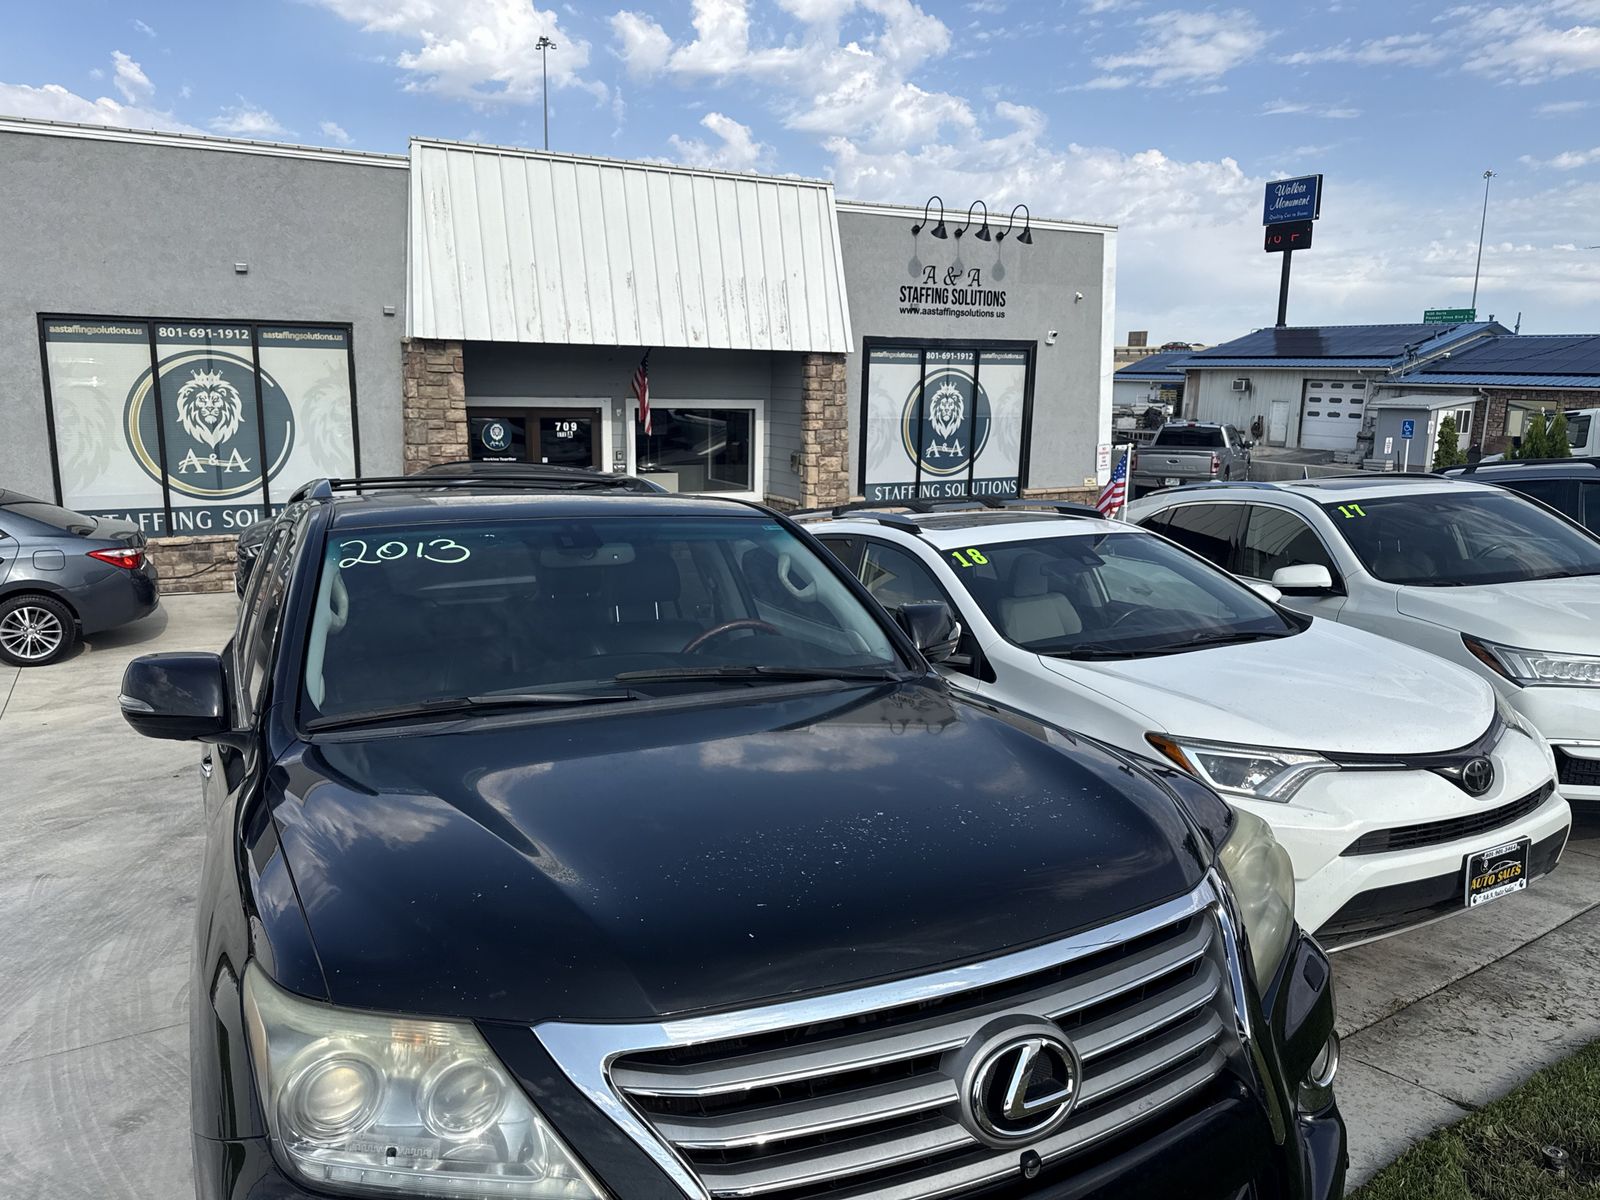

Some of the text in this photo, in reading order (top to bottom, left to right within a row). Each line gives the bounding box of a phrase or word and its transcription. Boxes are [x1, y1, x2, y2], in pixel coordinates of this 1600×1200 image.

[1274, 182, 1306, 196] Walker
[1270, 195, 1310, 210] Monument
[922, 265, 982, 287] A & A
[899, 285, 1007, 307] STAFFING SOLUTIONS
[159, 327, 249, 340] 801-691-1912
[926, 352, 973, 360] 801-691-1912
[555, 422, 577, 431] 709
[926, 439, 940, 458] A
[950, 438, 964, 457] A
[179, 447, 251, 474] A & A
[874, 480, 1017, 501] STAFFING SOLUTIONS
[1337, 504, 1367, 519] 17
[338, 538, 471, 568] 2013
[951, 548, 989, 568] 18
[1471, 874, 1496, 890] AUTO
[1498, 864, 1522, 882] SALES
